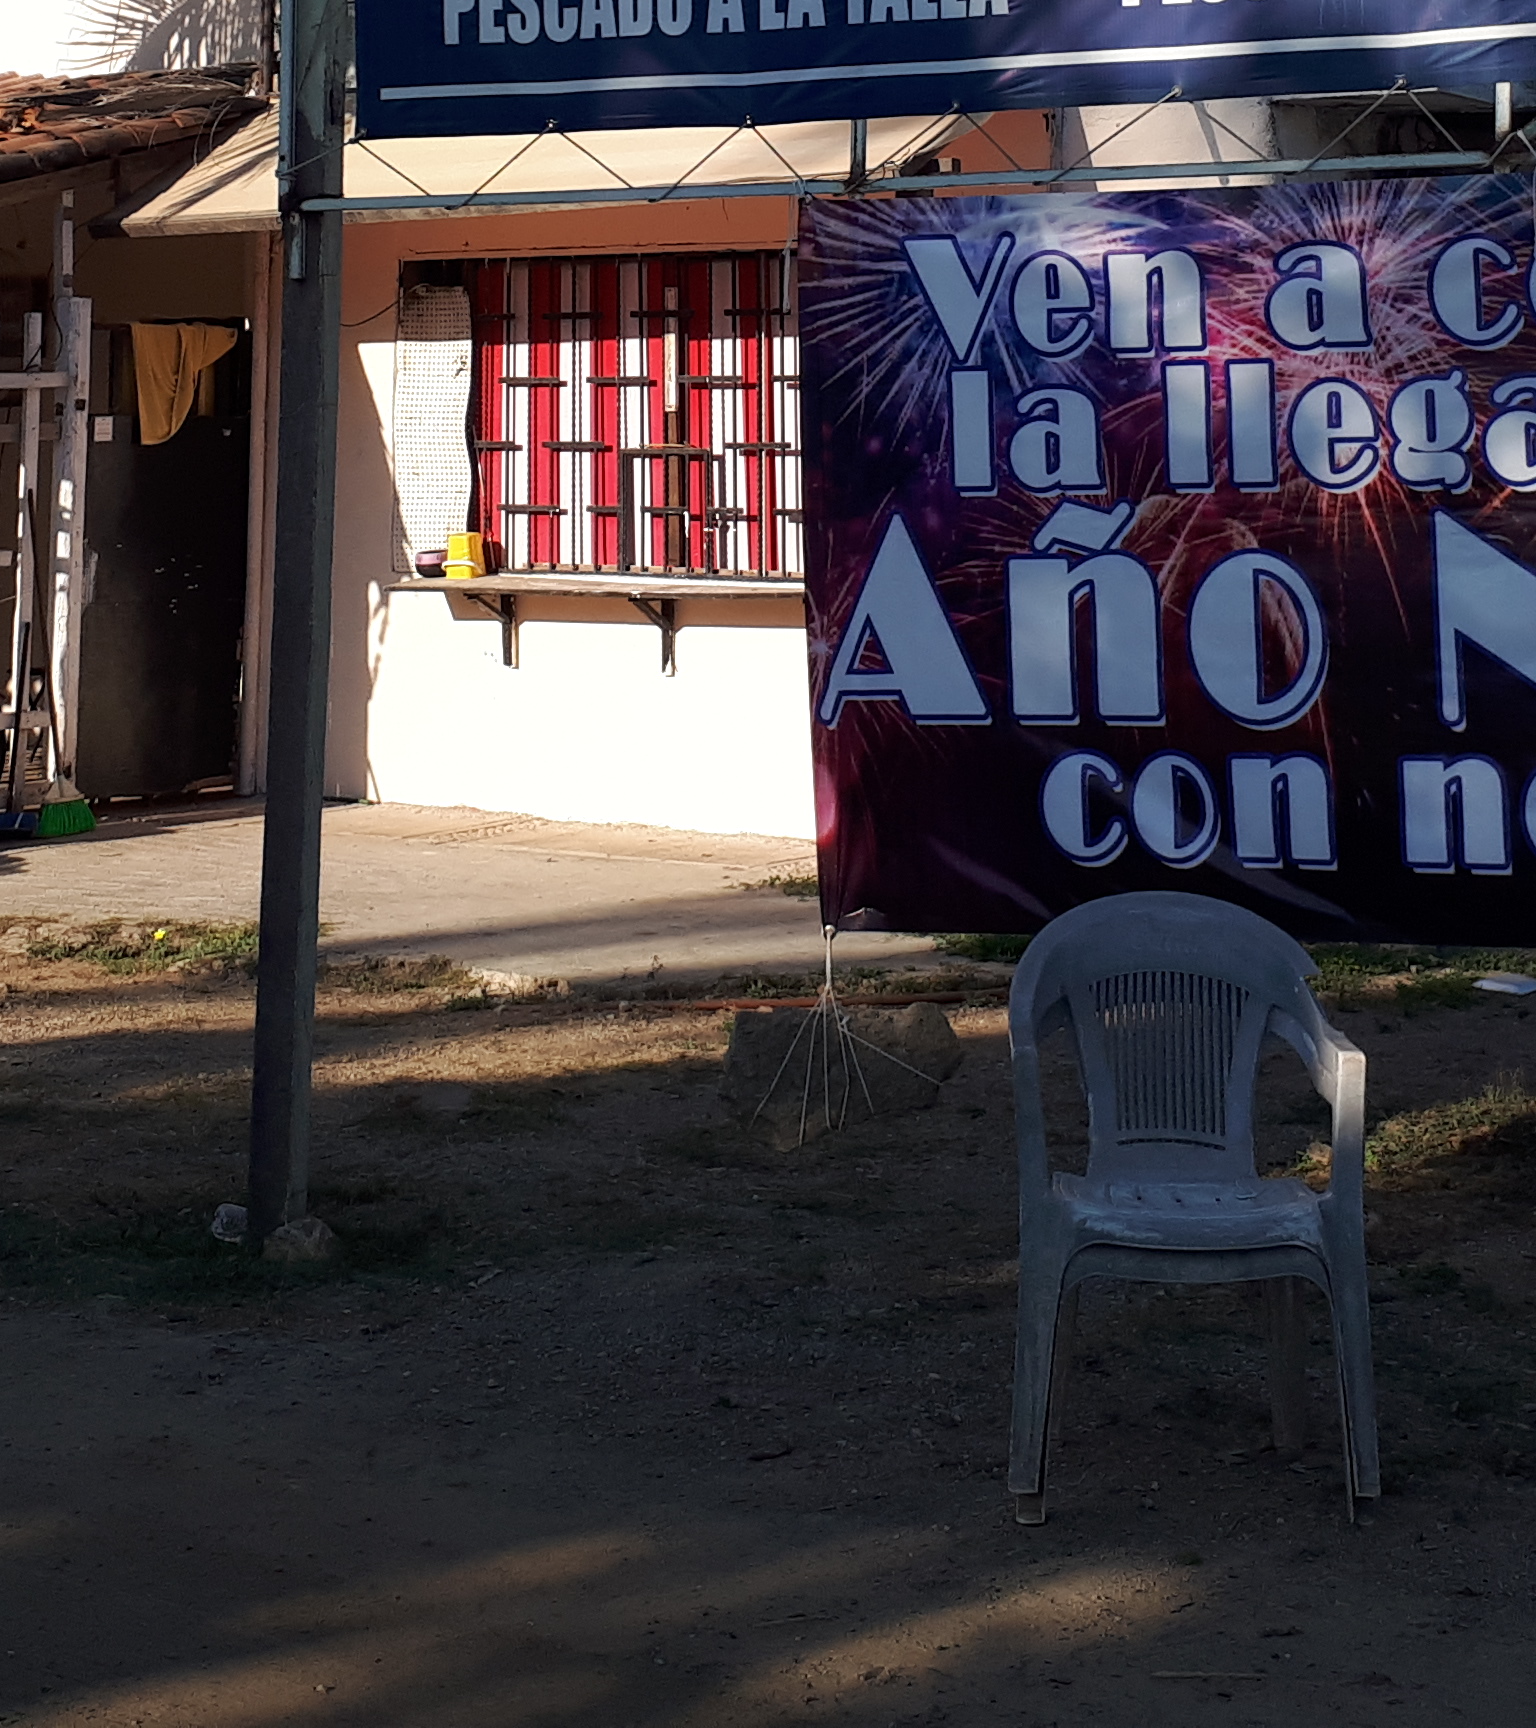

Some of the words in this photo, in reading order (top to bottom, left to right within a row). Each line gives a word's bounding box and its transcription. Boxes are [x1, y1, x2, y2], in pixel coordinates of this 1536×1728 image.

[902, 233, 1208, 364] Ven
[1267, 242, 1372, 352] a
[950, 369, 1105, 497] la
[818, 500, 1331, 733] Año
[1041, 750, 1338, 871] con
